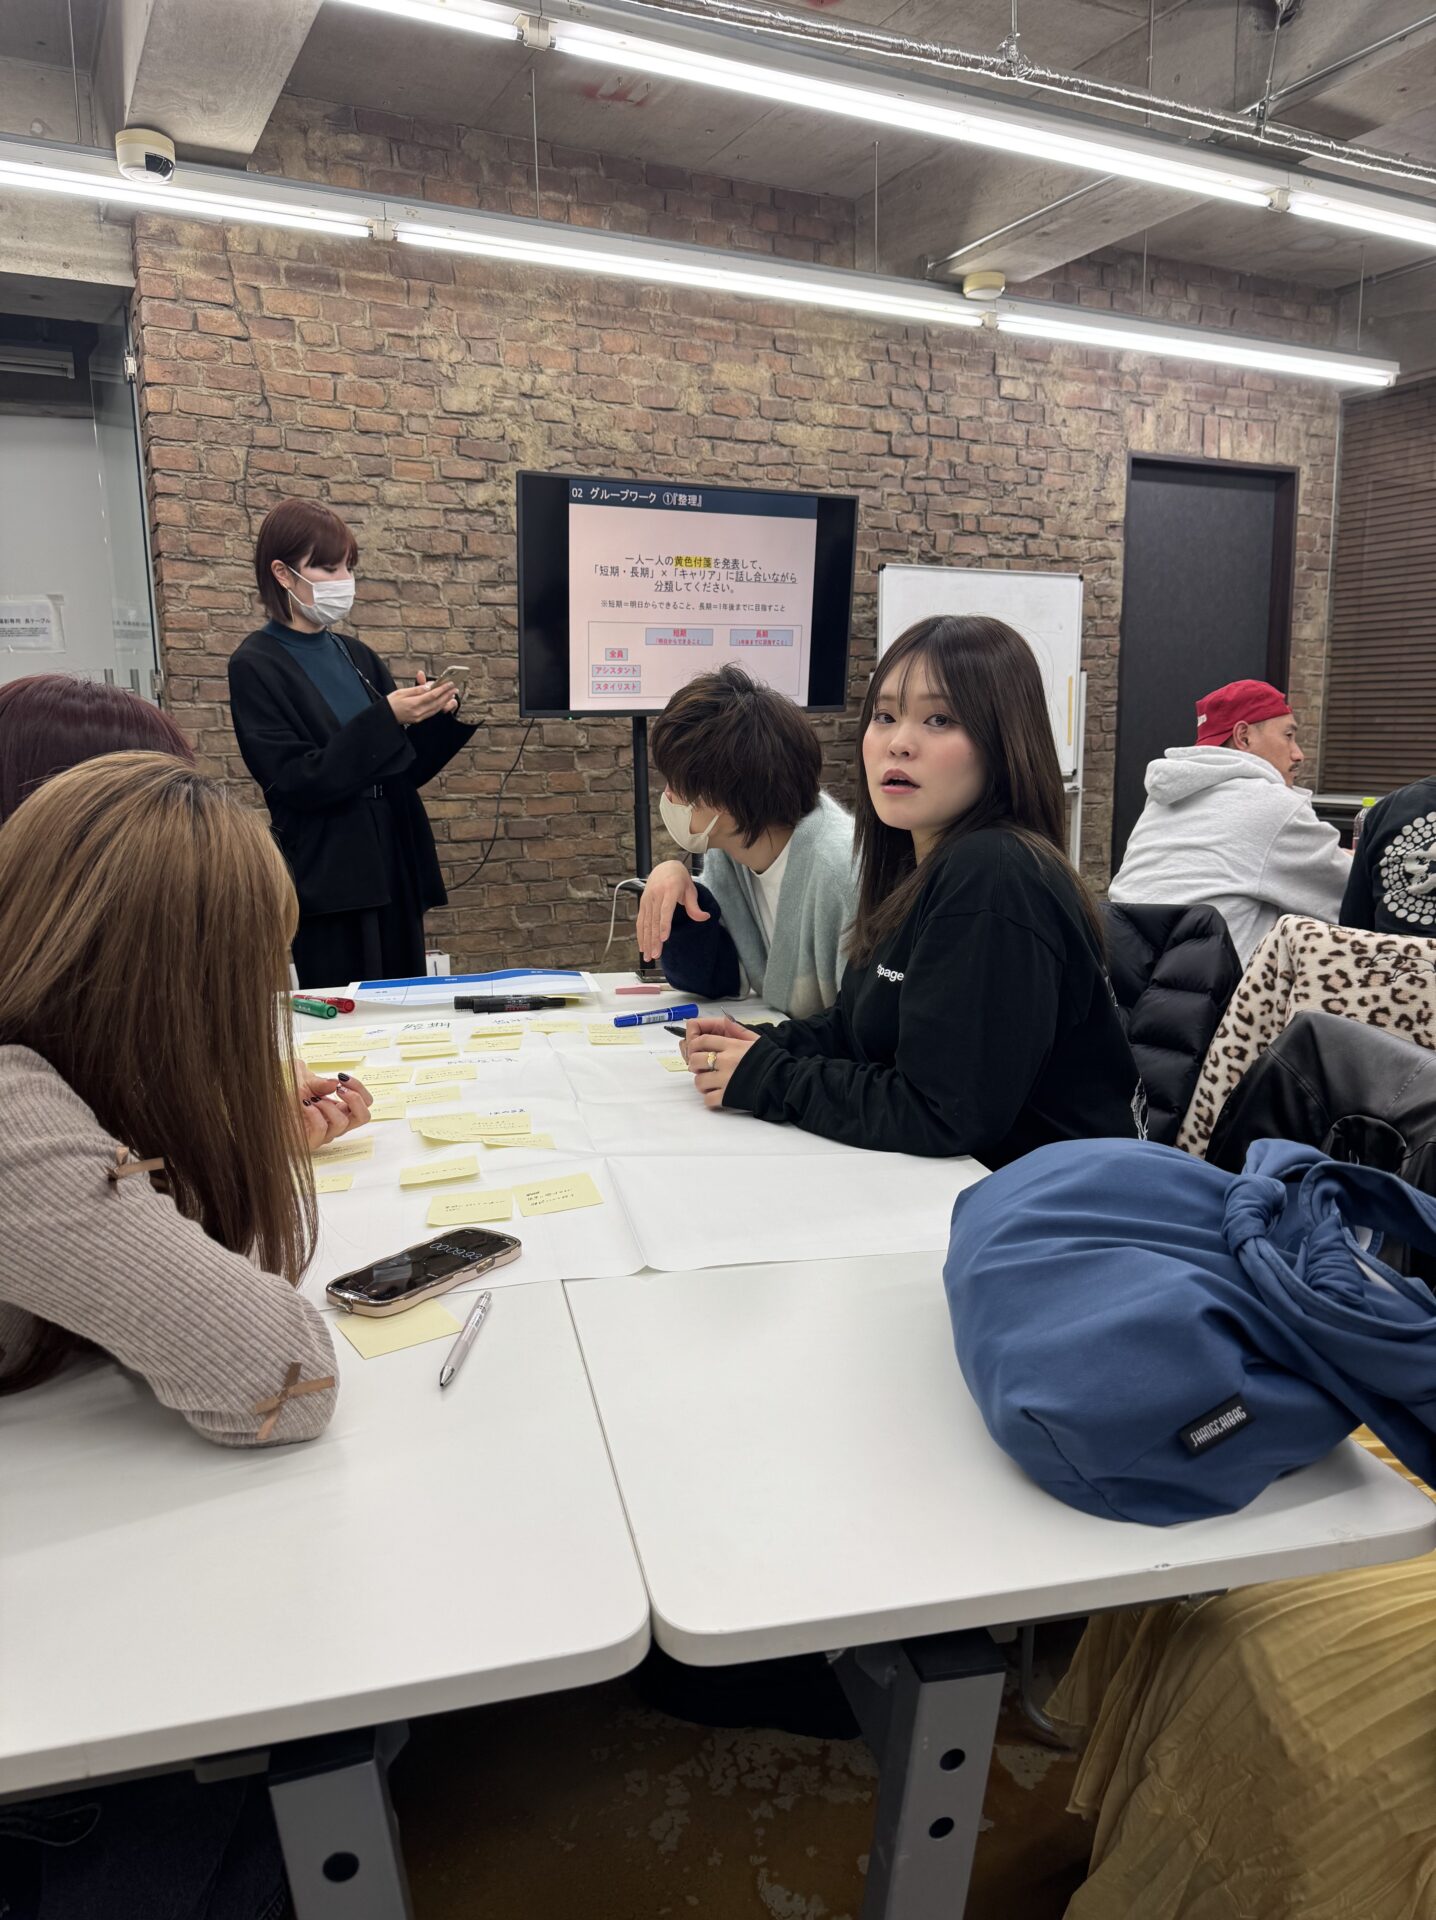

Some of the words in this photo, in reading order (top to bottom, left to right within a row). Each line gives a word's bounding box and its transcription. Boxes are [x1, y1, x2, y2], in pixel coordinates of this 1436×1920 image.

[571, 487, 583, 498] 02
[590, 487, 657, 503] グループワーク
[625, 554, 762, 570] 一人一人の黄色付箋を発表して、
[654, 580, 734, 594] 分類してください。
[595, 666, 637, 675] アシスタント
[595, 683, 637, 691] スタイリスト
